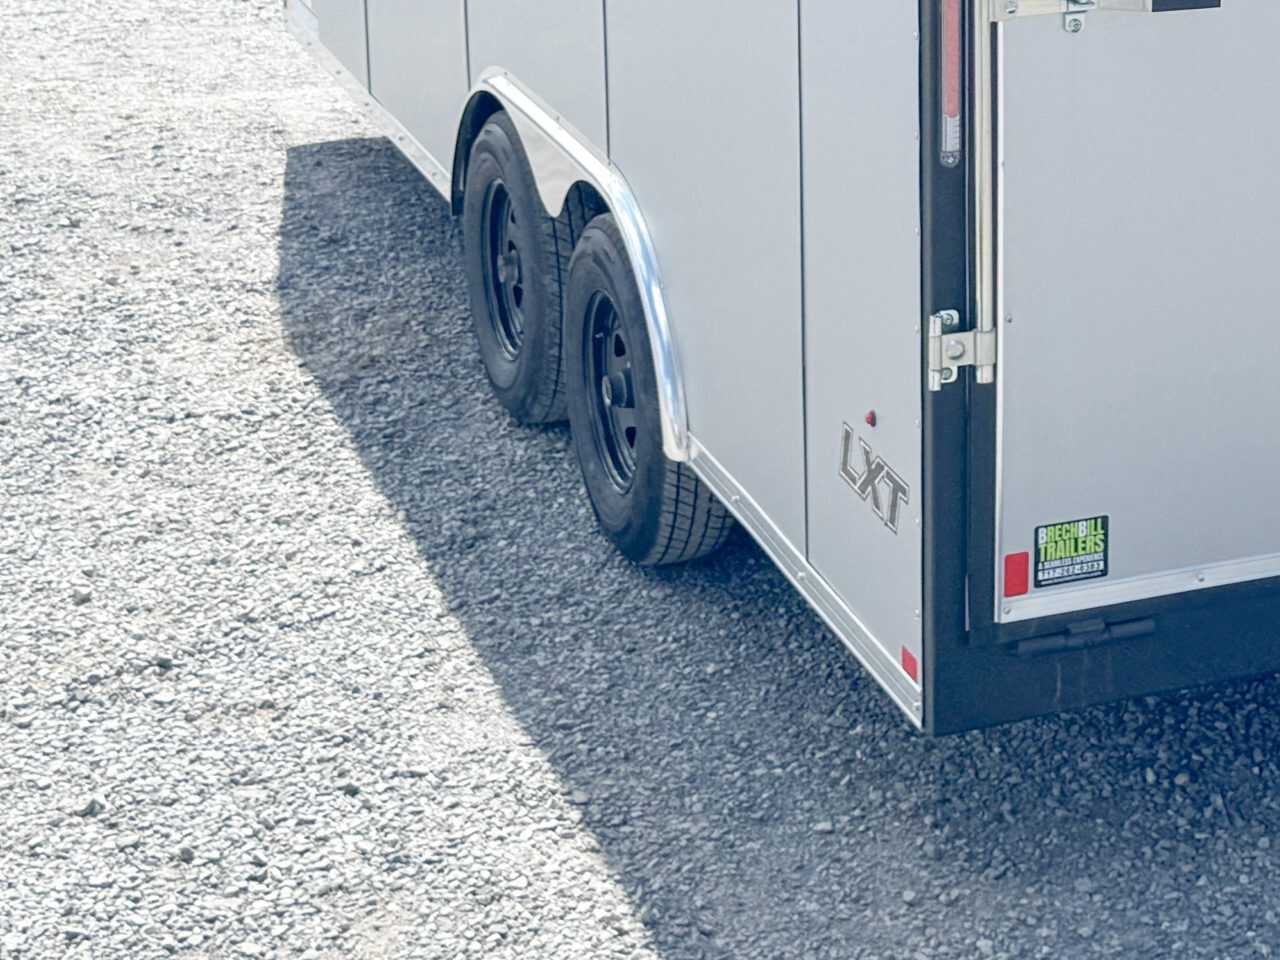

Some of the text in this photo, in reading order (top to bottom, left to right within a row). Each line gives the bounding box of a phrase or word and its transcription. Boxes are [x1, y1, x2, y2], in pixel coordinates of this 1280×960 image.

[839, 421, 910, 535] LXT
[1038, 518, 1105, 545] BRECHBILL
[1038, 534, 1105, 562] TRAILERS
